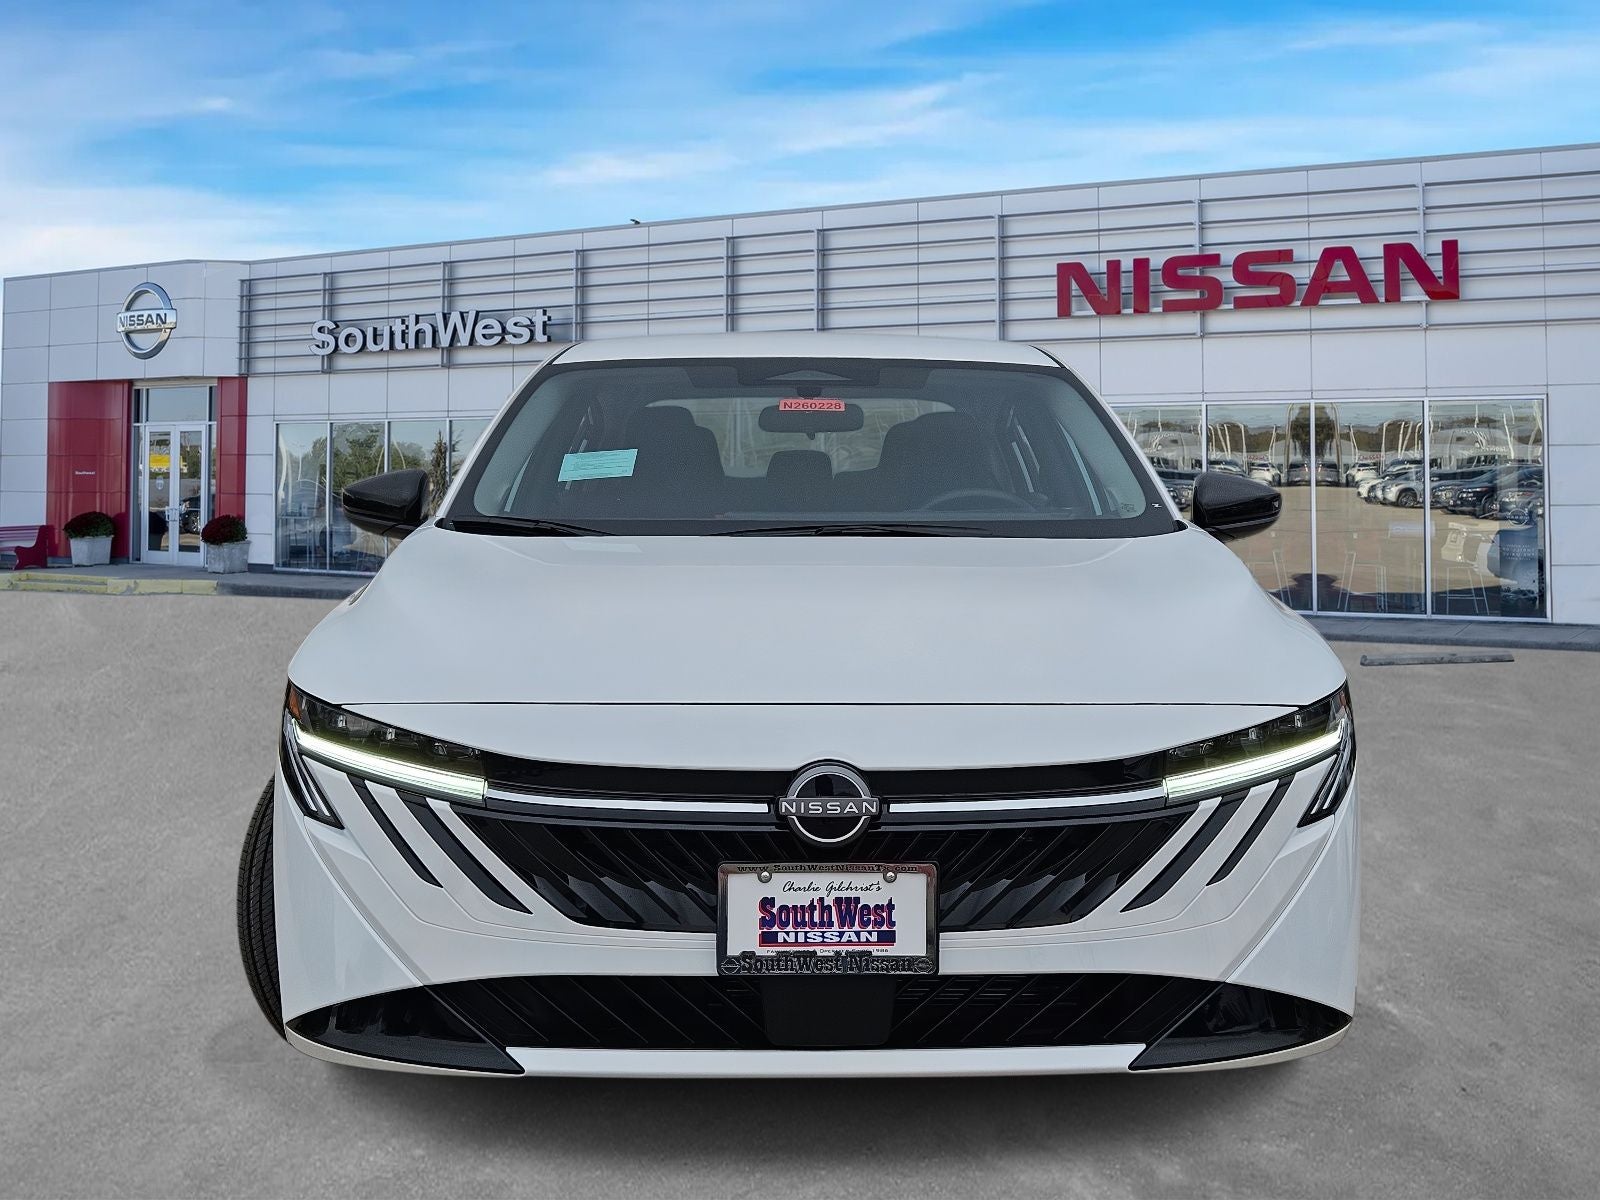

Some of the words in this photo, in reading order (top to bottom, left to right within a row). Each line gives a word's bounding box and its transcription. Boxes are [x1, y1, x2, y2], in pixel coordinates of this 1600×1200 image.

[1056, 239, 1460, 318] NISSAN
[119, 312, 168, 328] NISSAN
[309, 308, 552, 356] SouthWest
[783, 401, 842, 410] N260228
[781, 801, 877, 814] NISSAN
[737, 864, 918, 873] wwwSouthWestNissanTxcom
[782, 880, 822, 893] Charlie
[825, 880, 882, 897] Gilchrist's
[759, 897, 897, 930] SouthWest
[777, 931, 879, 943] NISSAN
